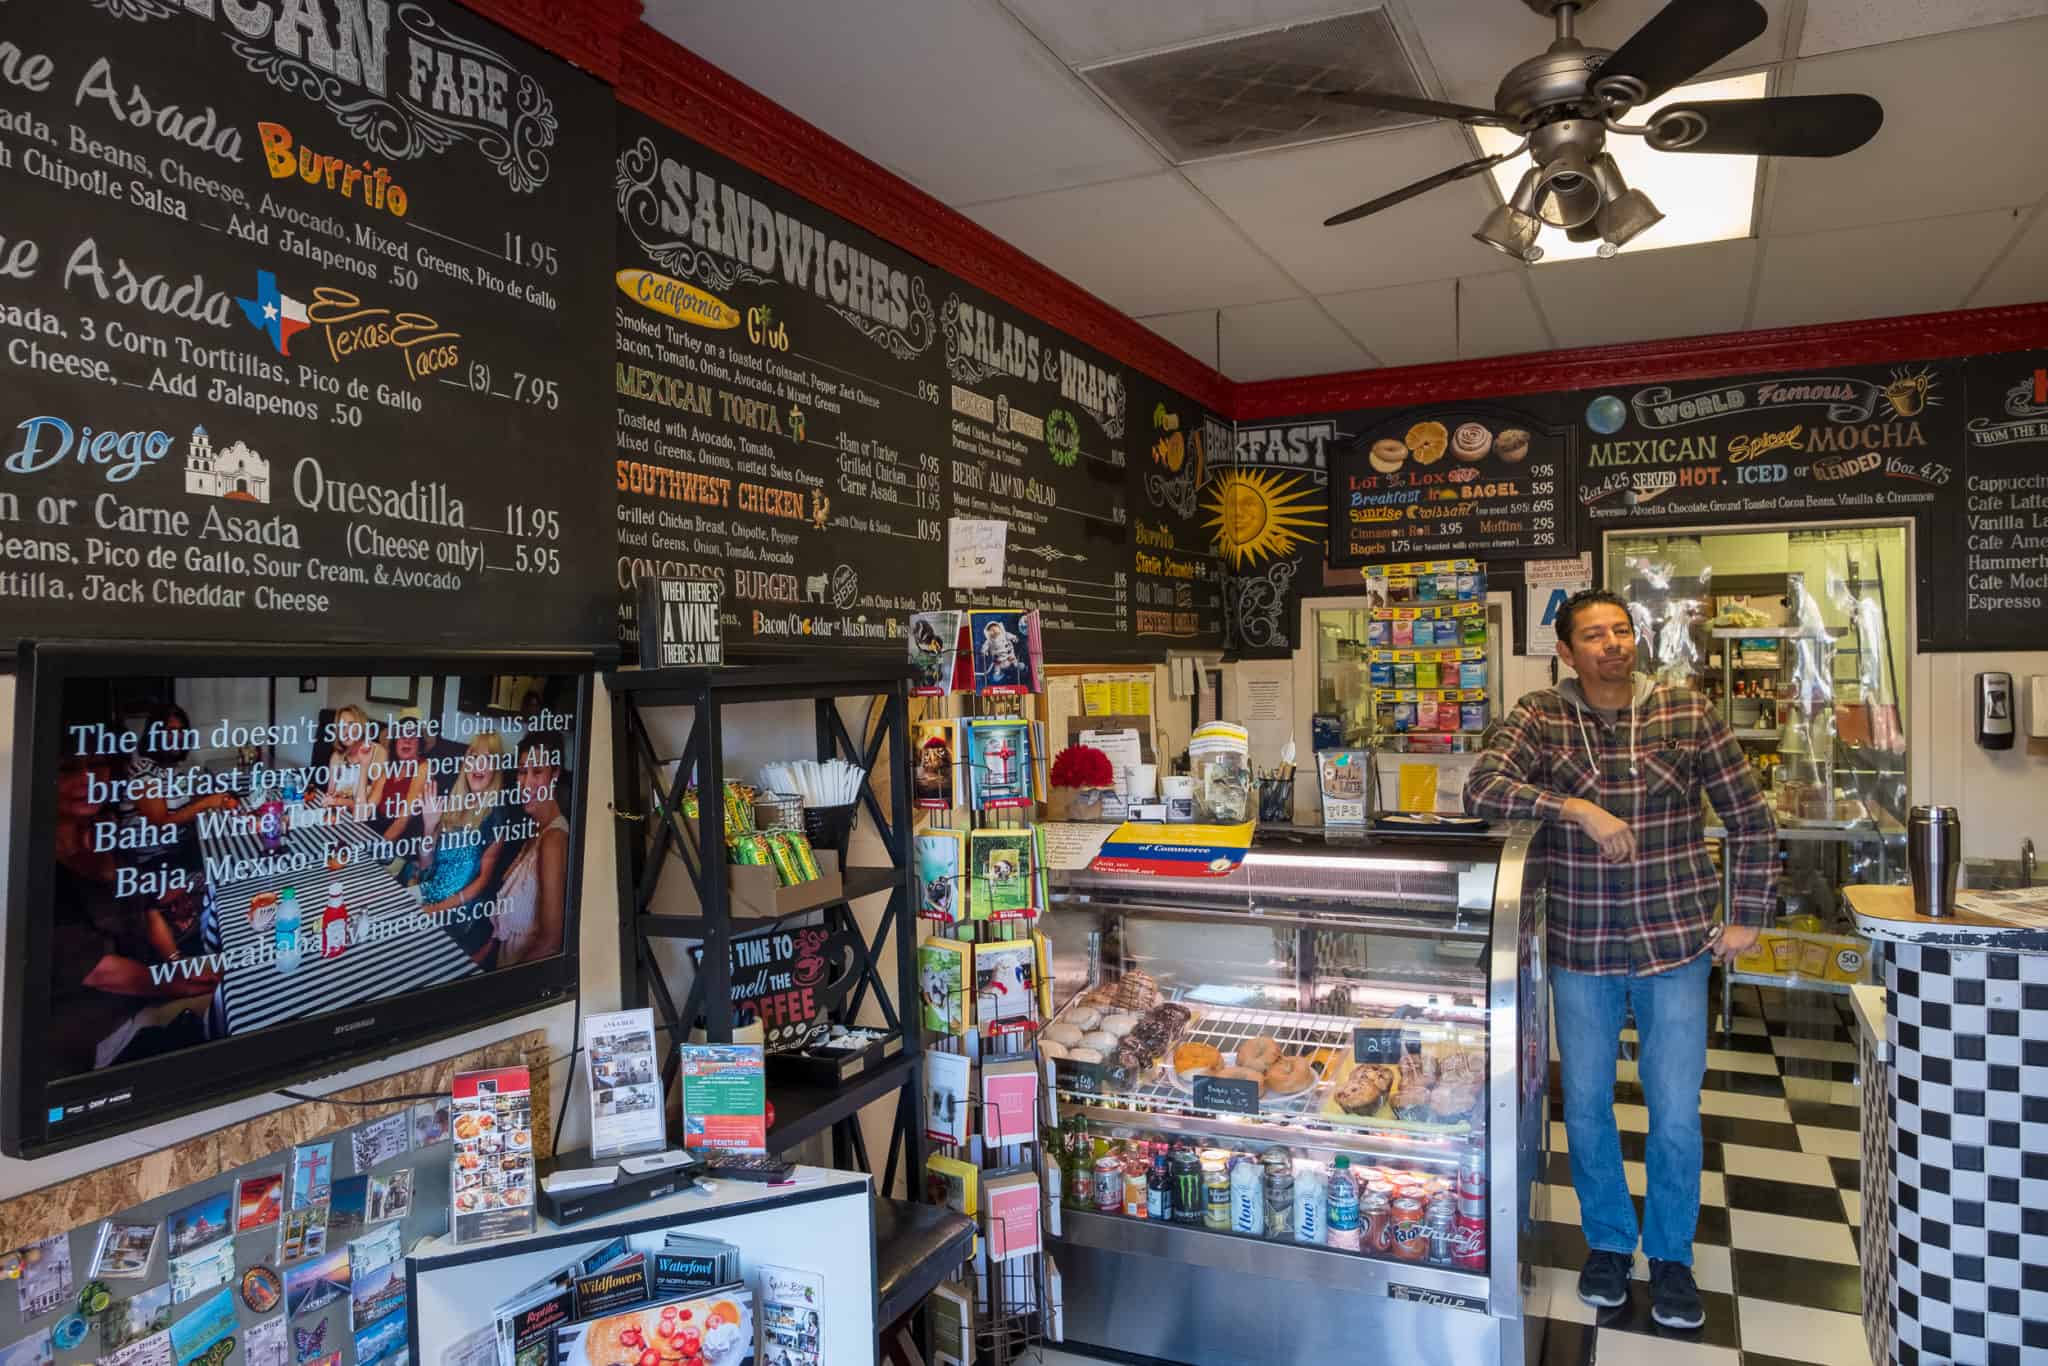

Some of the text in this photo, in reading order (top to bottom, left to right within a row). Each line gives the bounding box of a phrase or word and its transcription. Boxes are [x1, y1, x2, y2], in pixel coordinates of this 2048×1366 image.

[408, 37, 508, 129] FARE
[75, 56, 559, 276] Asada Burrito 11.95
[23, 148, 377, 281] Chipotle Salsa Add Jalapenos
[68, 124, 557, 311] Beans, Cheese, Mixed Greens, Pico Gallo
[660, 157, 909, 331] SANDWICHES
[637, 272, 721, 322] California
[63, 237, 559, 411] Asada 7.95
[105, 322, 423, 412] Corn Pico de Gallo
[664, 324, 763, 372] Turkey toasted
[959, 302, 1040, 384] SALADS
[1042, 348, 1060, 383] &
[1060, 350, 1119, 418] WRAPS
[8, 338, 318, 420] Cheese, Add Jalapenos
[615, 361, 940, 475] MEXICAN TORTA 9.95
[616, 407, 661, 433] Toasted
[665, 421, 688, 441] with
[1653, 382, 1859, 425] WORLD Famous
[1587, 420, 1929, 468] MEXICAN Spiced MOCHA
[1975, 424, 2036, 444] FROM THE
[5, 416, 560, 541] Diego Quesadilla 11.95
[616, 430, 898, 504] Mixed Greens, melted Cheese Asada
[951, 459, 984, 490] BERRY
[1026, 478, 1056, 507] SALAD
[1410, 464, 1555, 486] Lox 9.95
[1603, 471, 1631, 490] 4.25
[1632, 471, 1678, 488] SERVED
[1735, 463, 1789, 485] ICED
[1794, 463, 1811, 478] or
[1813, 452, 1883, 482] BLENDED
[1885, 456, 1915, 477] 16oz
[1920, 461, 1952, 485] 4.75
[615, 459, 942, 543] SOUTHWEST CHICKEN 10.95
[1349, 499, 1555, 523] Sunrise Croissant 6.95
[1351, 481, 1555, 506] Breakfast BAGEL 5.95
[1709, 499, 1742, 513] Ground
[1838, 493, 1874, 506] Vanilla
[1887, 490, 1936, 504] Cinnamon
[37, 493, 560, 576] or Carne Asada (Cheese only) 5.95
[617, 503, 801, 545] Grilled Chicken Pepper
[1439, 517, 1555, 536] 3.95 Muffins 2.95
[1967, 514, 2025, 531] Vanilla
[86, 538, 461, 591] Pico de Gallo, Sour Avocado
[617, 527, 794, 565] Mixed Avocado
[1349, 532, 1555, 556] Bagels 1.75 2.95
[82, 574, 329, 612] Jack Cheddar Cheese
[660, 581, 719, 603] WHEN THERE'S
[734, 569, 801, 602] BURGER
[1967, 592, 2042, 612] Espresso
[662, 603, 720, 642] A WINE
[663, 643, 721, 665] THERE'S A WAY
[70, 708, 573, 757] The fun doesn't stop us after
[86, 744, 562, 805] breakfast own personal Aha
[93, 776, 559, 854] Baha Wine in the vineyards of
[115, 818, 542, 900] Baja, Mexico. For more info. visit:
[1138, 844, 1211, 855] of Commerce
[735, 934, 793, 968] TIME TO
[1841, 952, 1859, 964] 50
[769, 972, 792, 989] THE
[578, 1269, 643, 1297] Wildflowers
[658, 1257, 714, 1275] Waterfowl
